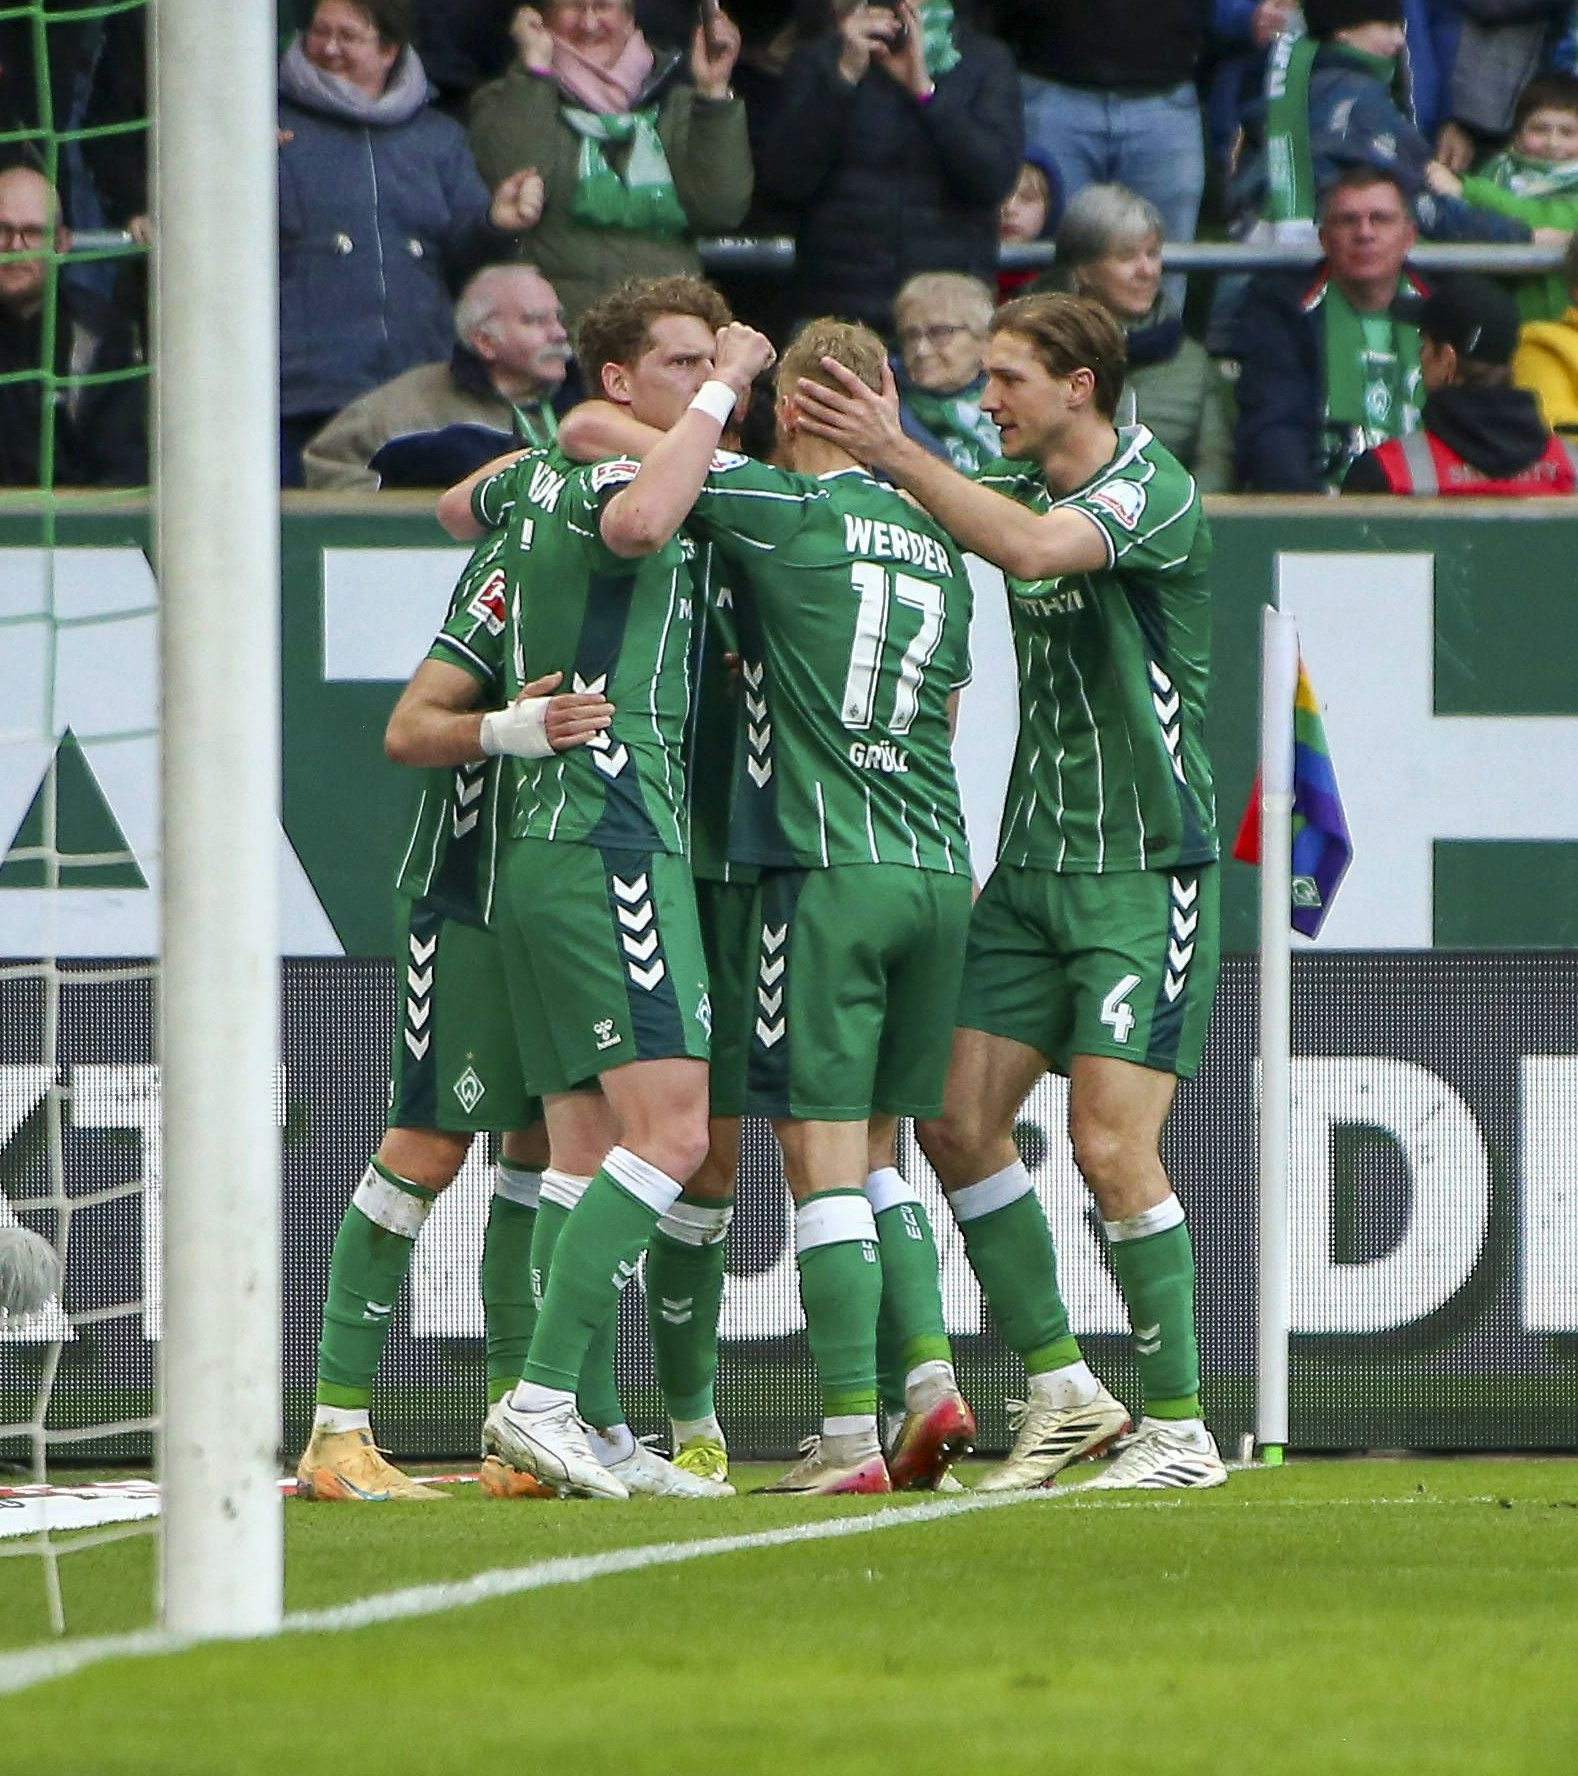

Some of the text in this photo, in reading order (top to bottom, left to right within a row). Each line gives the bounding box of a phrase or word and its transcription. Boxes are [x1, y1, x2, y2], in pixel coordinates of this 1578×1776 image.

[843, 513, 953, 578] WERDER
[841, 561, 946, 736] 17
[850, 739, 909, 772] GRÜLL
[1099, 973, 1143, 1043] 4
